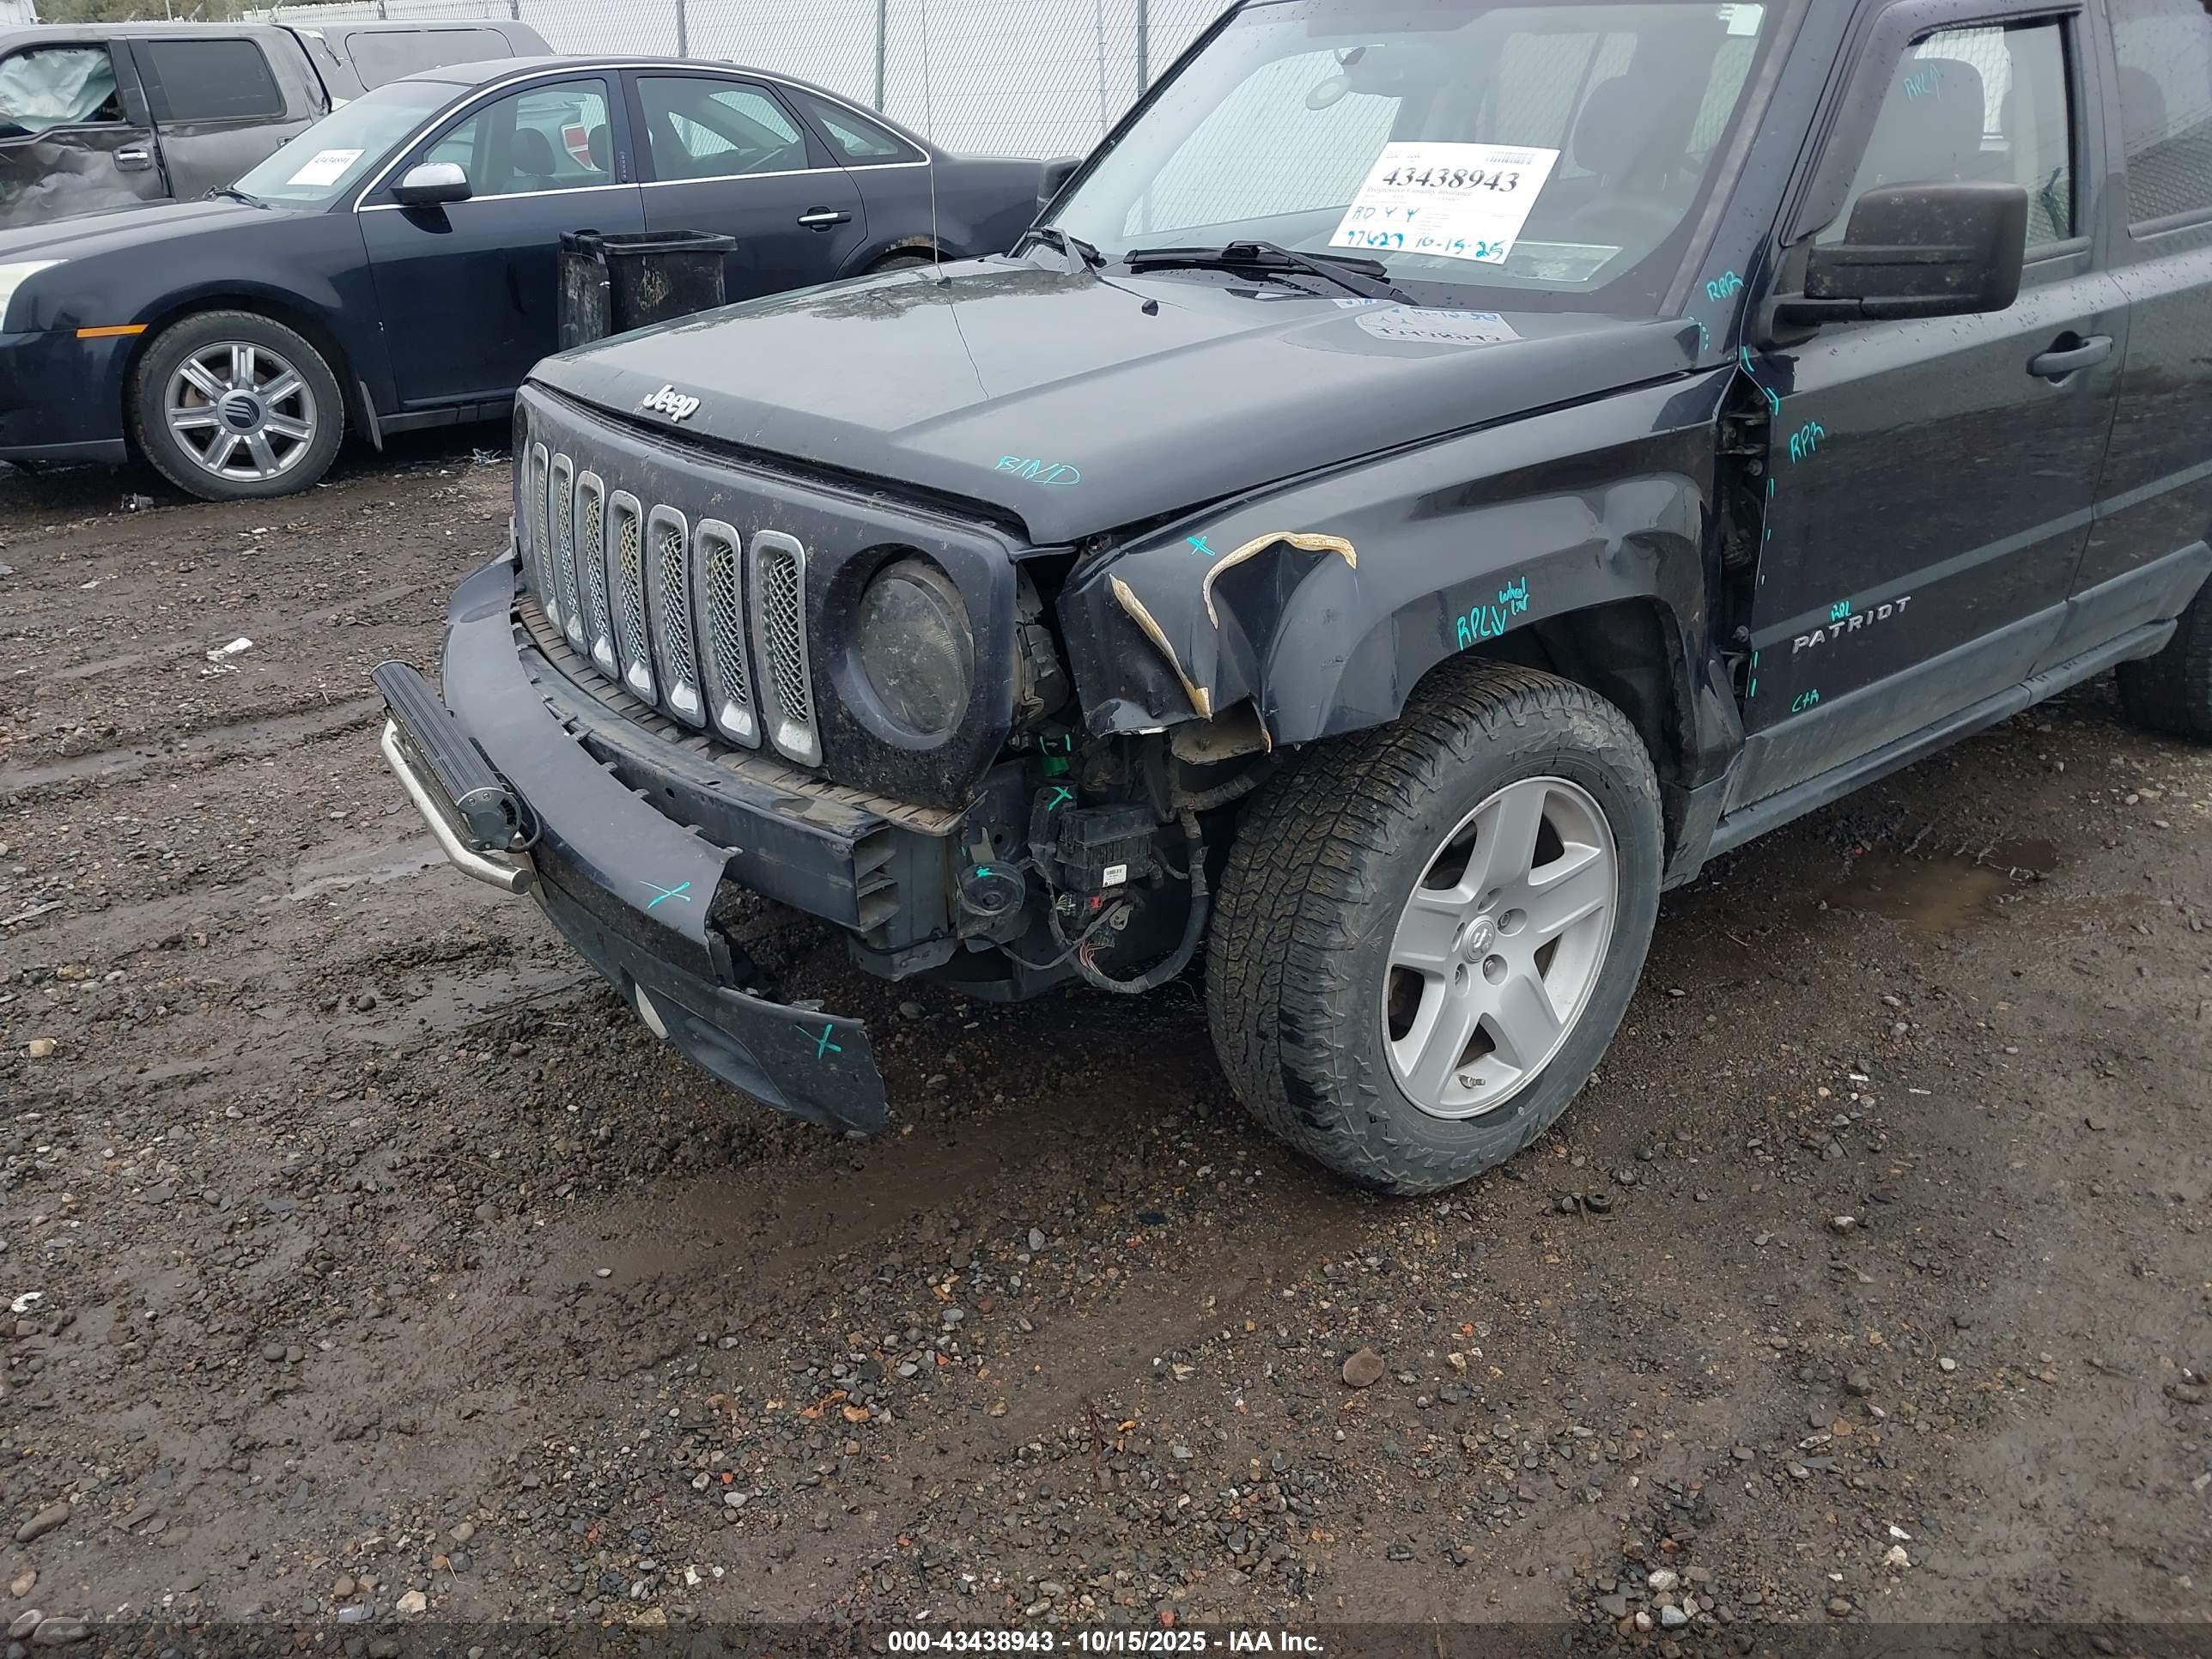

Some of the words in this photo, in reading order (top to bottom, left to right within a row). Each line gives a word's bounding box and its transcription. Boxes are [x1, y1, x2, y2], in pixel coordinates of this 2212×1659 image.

[1382, 167, 1520, 192] 43438943
[642, 384, 700, 422] Jeep
[1791, 596, 1911, 654] PATRIOT
